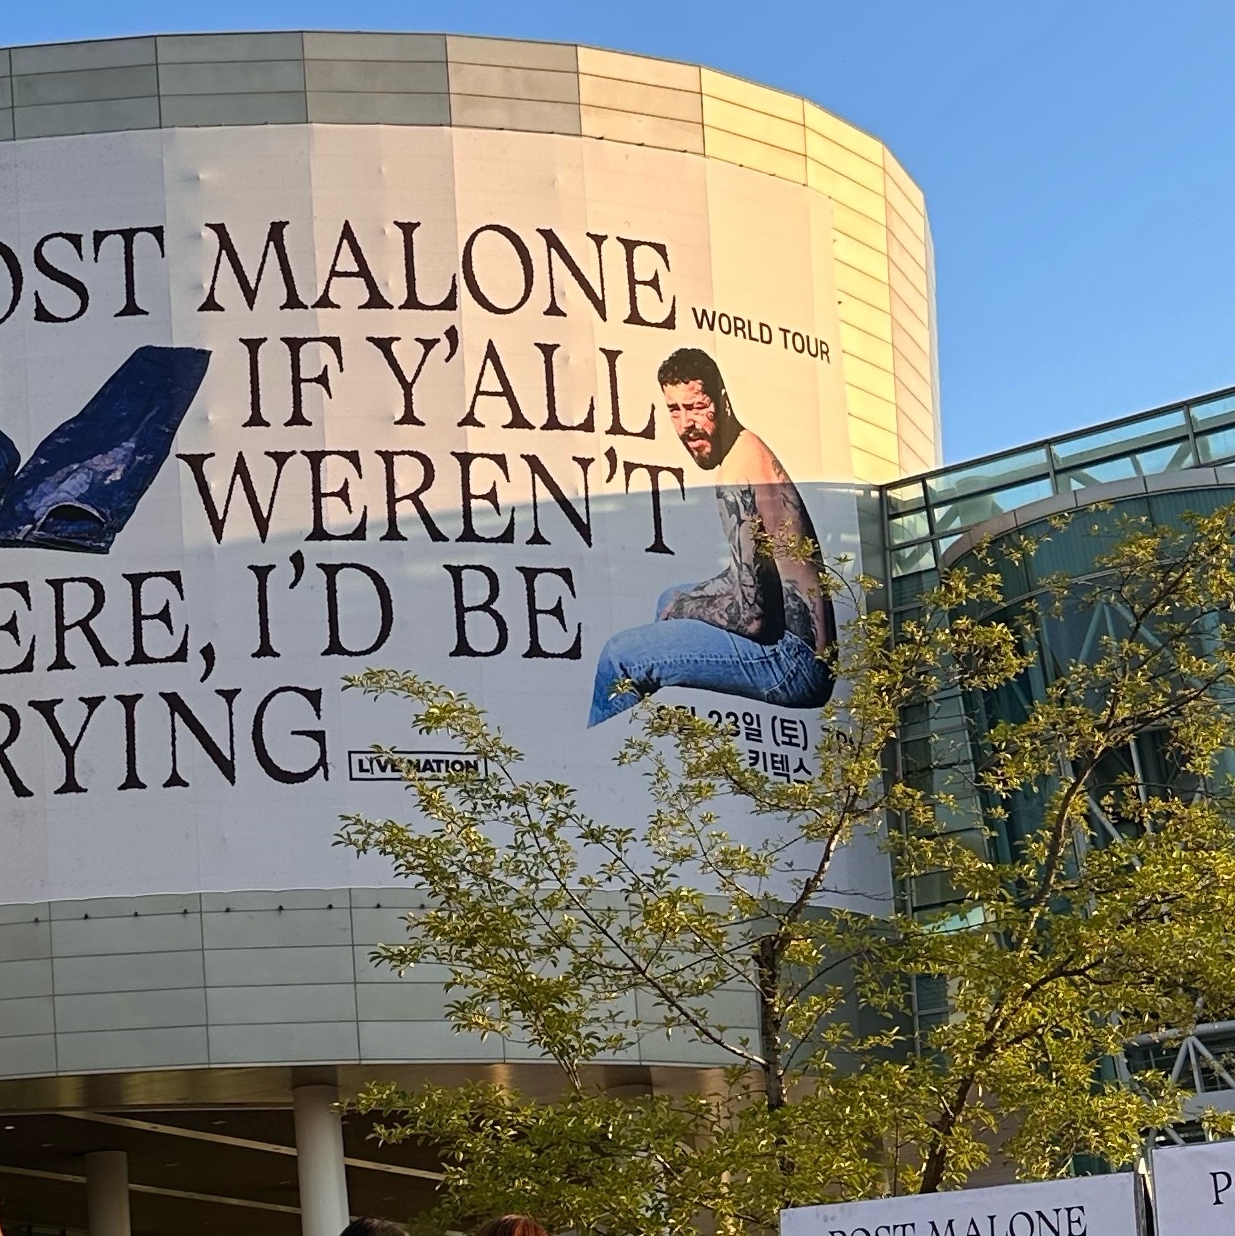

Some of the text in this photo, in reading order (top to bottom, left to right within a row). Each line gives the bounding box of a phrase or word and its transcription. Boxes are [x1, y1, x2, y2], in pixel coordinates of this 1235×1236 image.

[197, 219, 676, 330] MALONE
[241, 326, 656, 440] IF Y'ALL
[692, 306, 831, 365] WORLD TOUR
[177, 449, 685, 555] WEREN'T
[250, 550, 394, 659] I'D
[449, 563, 582, 661] BE
[771, 715, 808, 751] (토)
